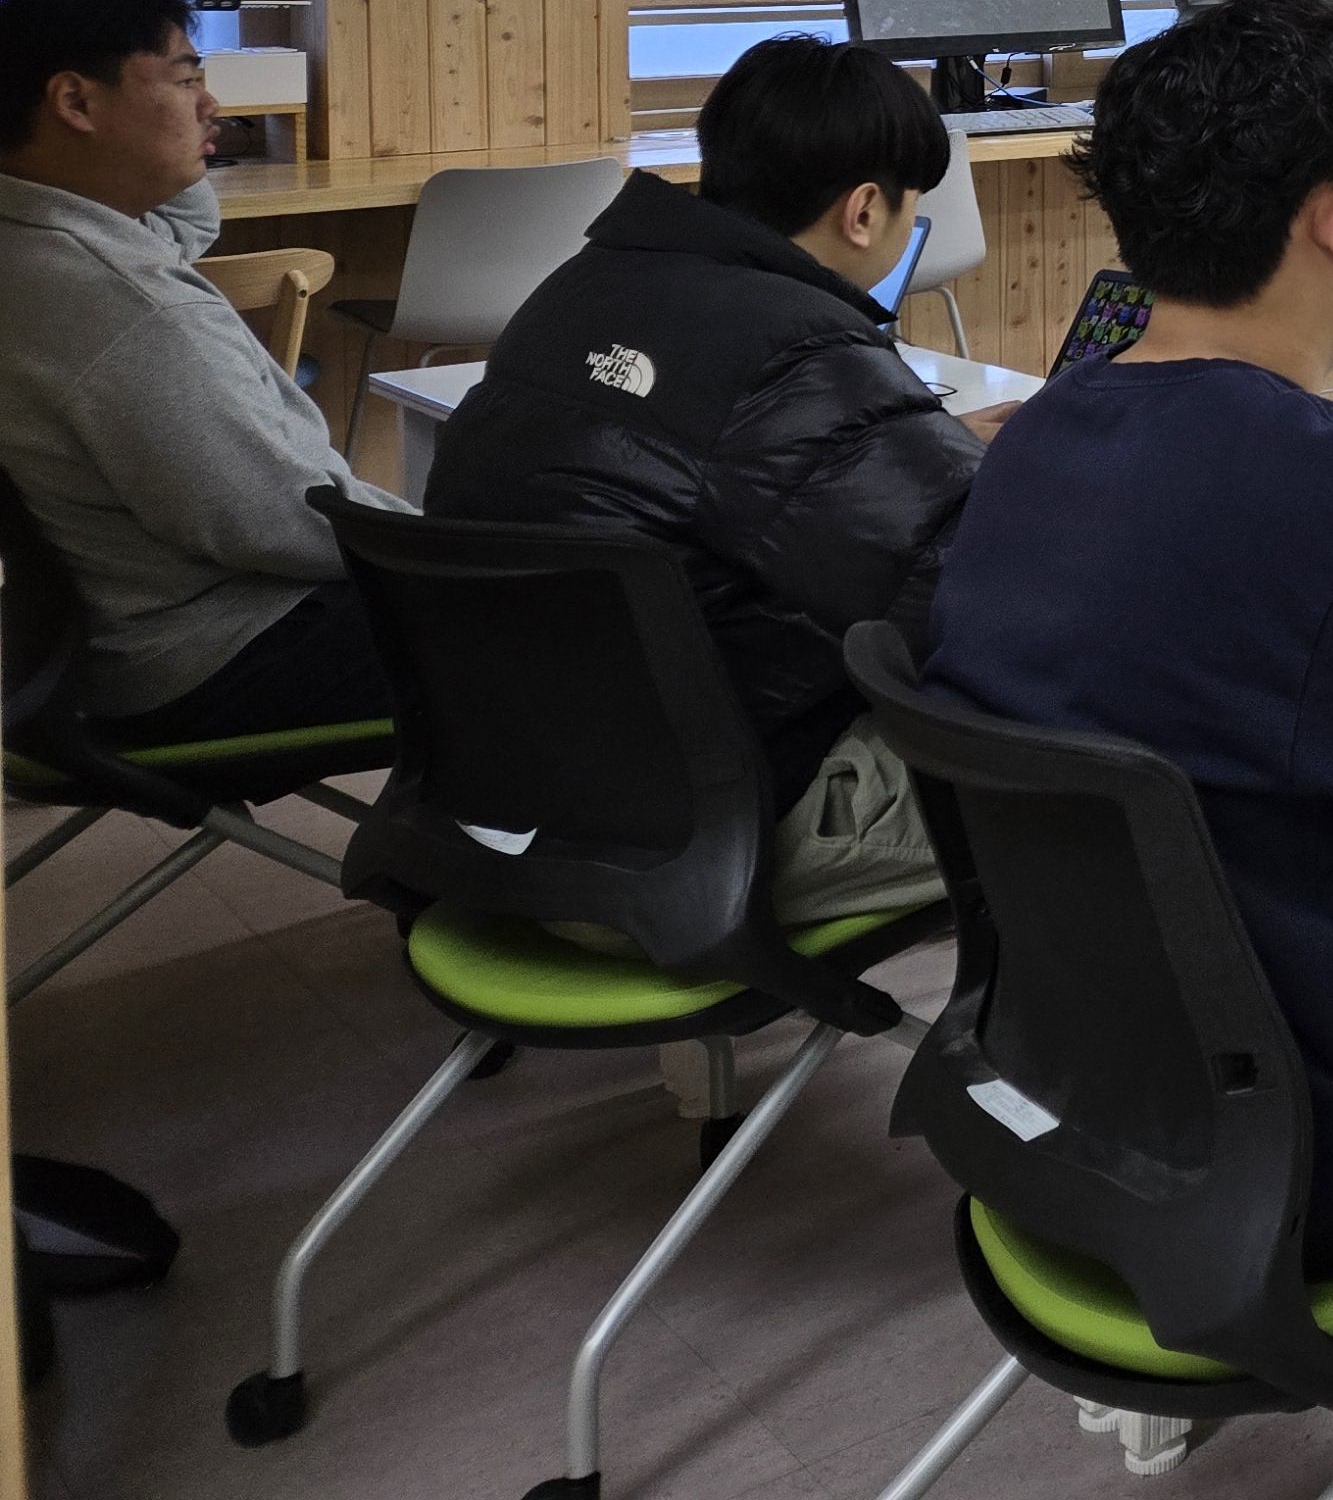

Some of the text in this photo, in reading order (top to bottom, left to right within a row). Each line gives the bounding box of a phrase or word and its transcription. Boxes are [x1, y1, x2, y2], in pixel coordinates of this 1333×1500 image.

[585, 351, 632, 376] NORTH
[610, 344, 639, 363] THE
[589, 367, 625, 389] FACE
